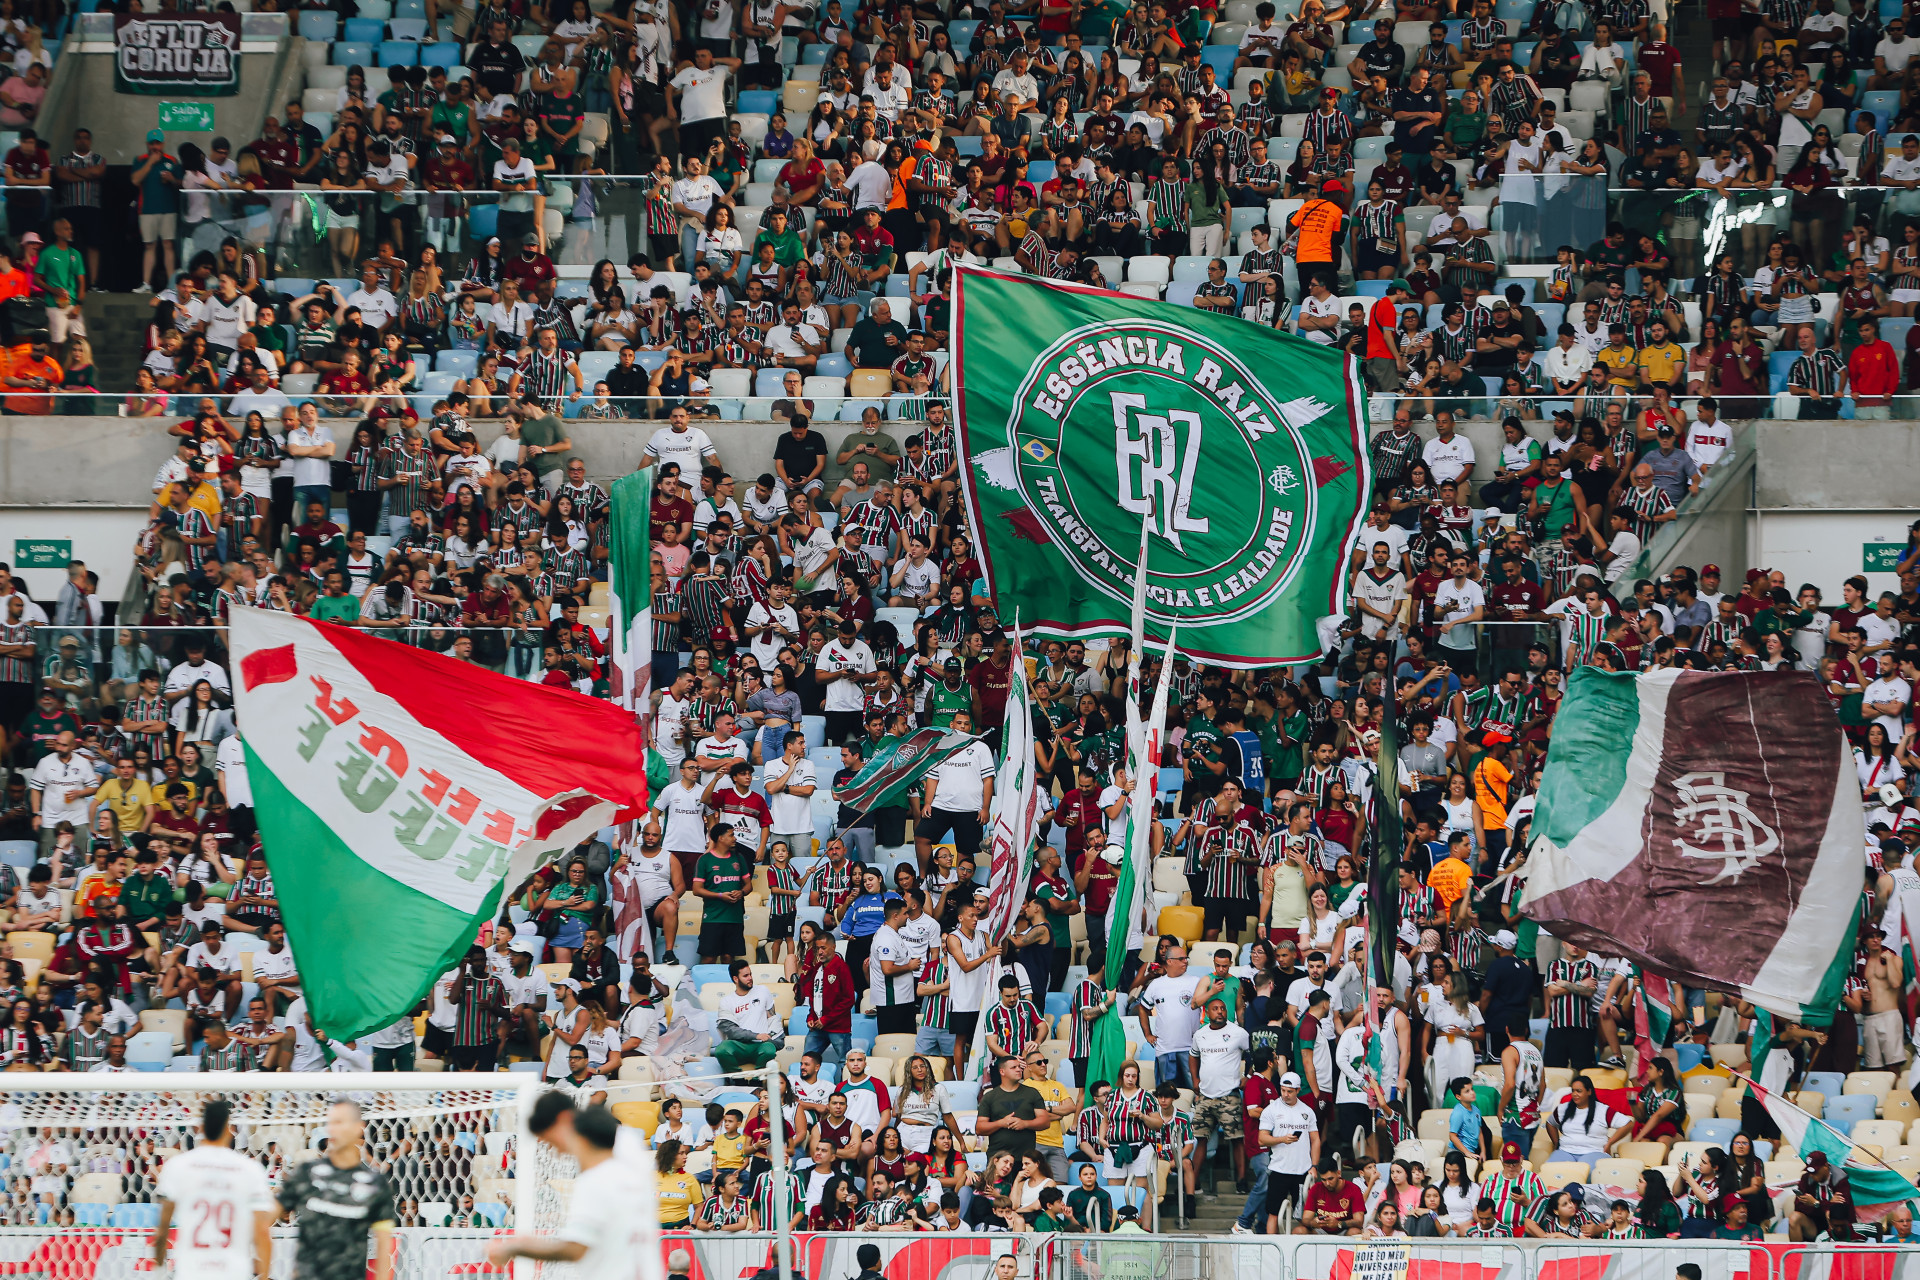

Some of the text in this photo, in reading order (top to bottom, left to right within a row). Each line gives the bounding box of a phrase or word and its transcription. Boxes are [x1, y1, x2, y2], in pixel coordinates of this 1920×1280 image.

[149, 25, 203, 49] FLU
[122, 48, 229, 73] CORUJA
[1031, 334, 1279, 442] ESSÊNCIA RAIZ
[666, 445, 692, 453] SUPERBET
[29, 543, 57, 553] SAÍDA
[1197, 585, 1215, 608] E
[1211, 506, 1294, 605] LEALDADE
[898, 934, 924, 944] UPERBET
[735, 1002, 750, 1013] UFC
[192, 1199, 235, 1248] 29
[1355, 1251, 1374, 1262] HOJE
[1388, 1250, 1406, 1261] MEU
